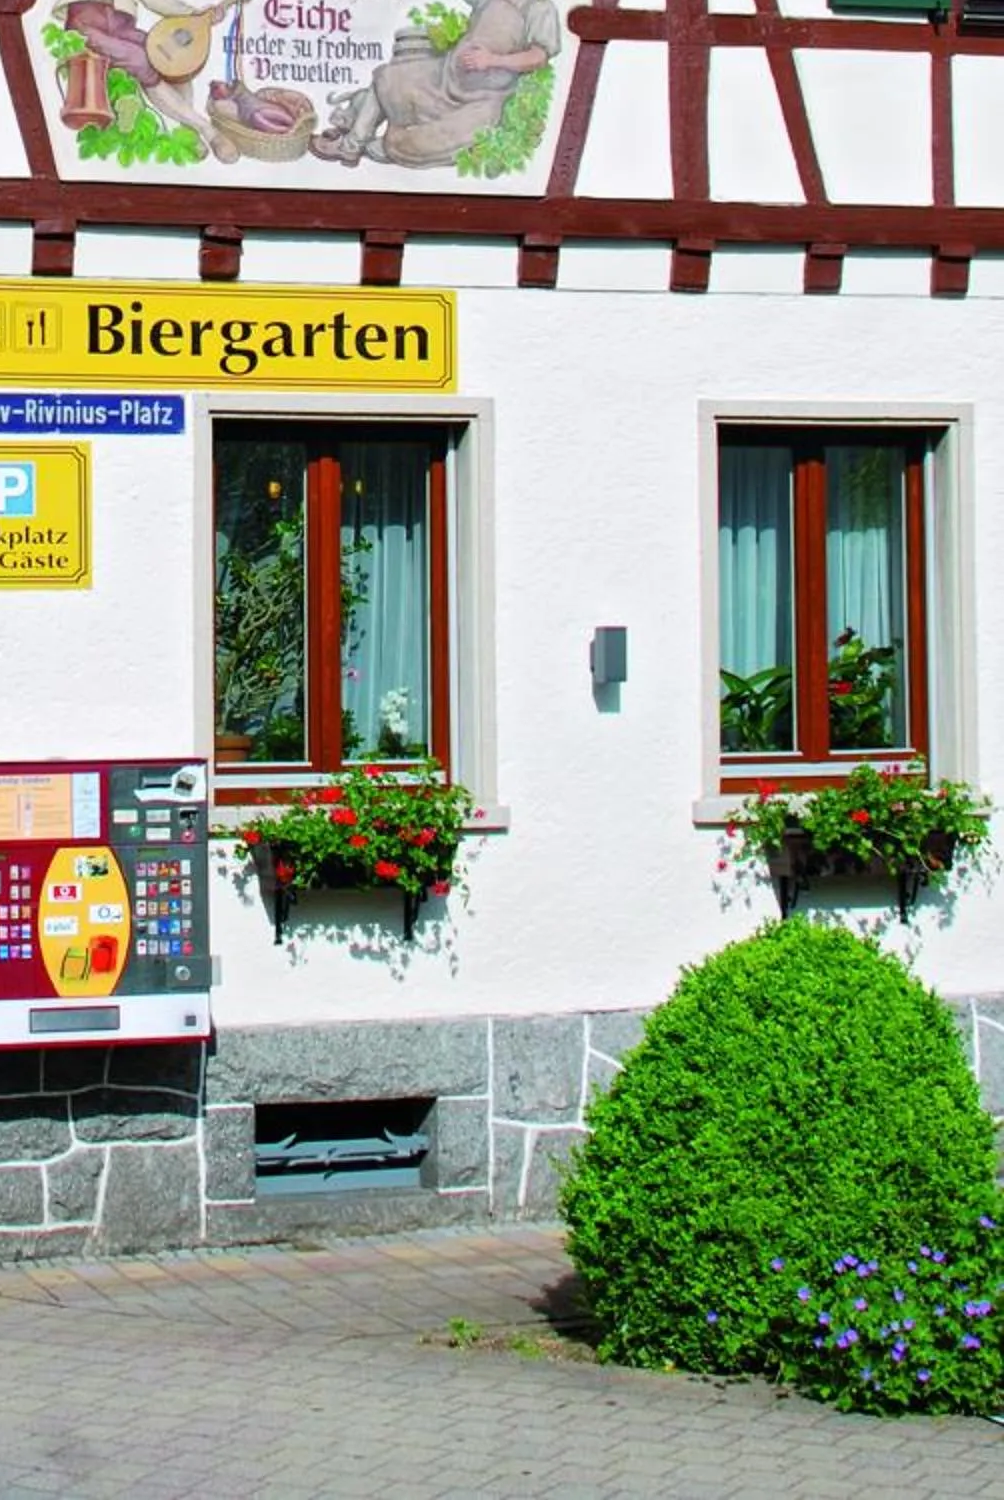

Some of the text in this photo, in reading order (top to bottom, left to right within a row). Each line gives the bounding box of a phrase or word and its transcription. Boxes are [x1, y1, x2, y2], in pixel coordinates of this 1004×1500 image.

[290, 36, 312, 58] zu
[316, 35, 383, 61] frohem
[86, 301, 430, 377] Biergarten
